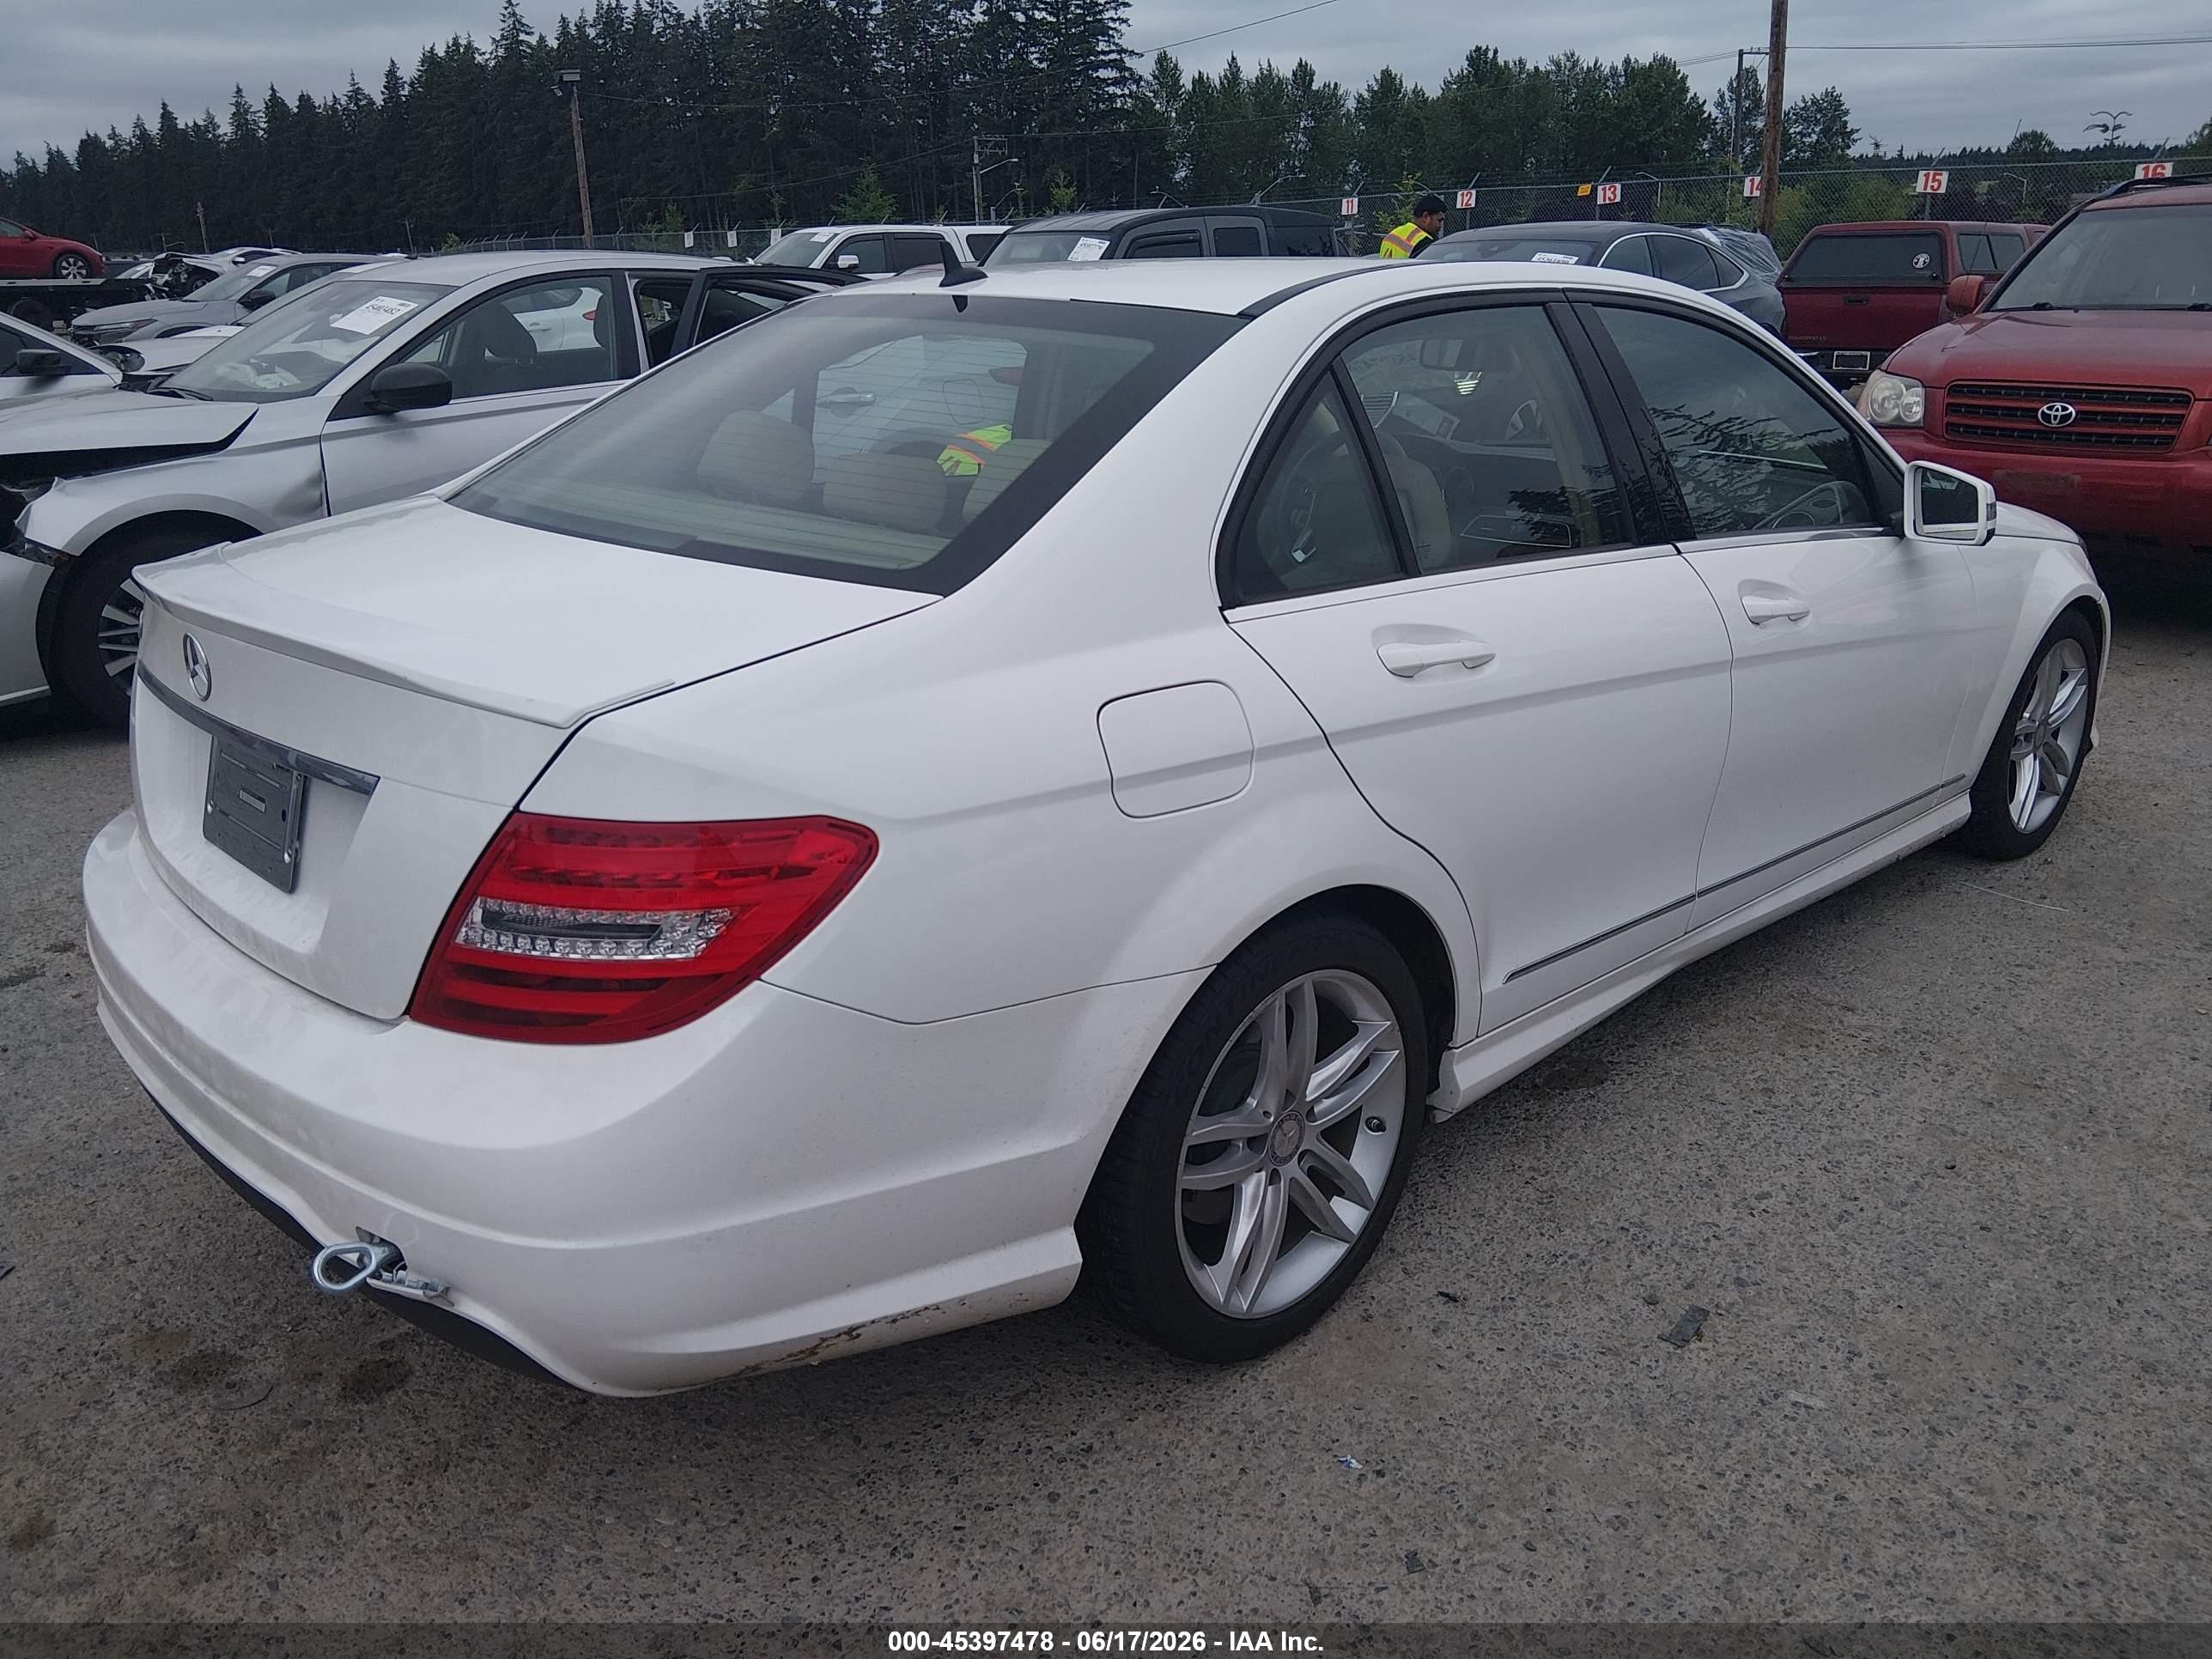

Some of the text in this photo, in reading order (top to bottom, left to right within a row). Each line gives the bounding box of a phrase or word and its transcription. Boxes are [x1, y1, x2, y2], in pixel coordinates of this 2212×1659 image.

[2142, 164, 2166, 179] 16
[1923, 172, 1943, 191] 15
[1460, 191, 1473, 207] 12
[1601, 185, 1617, 203] 13
[1346, 198, 1354, 214] 11
